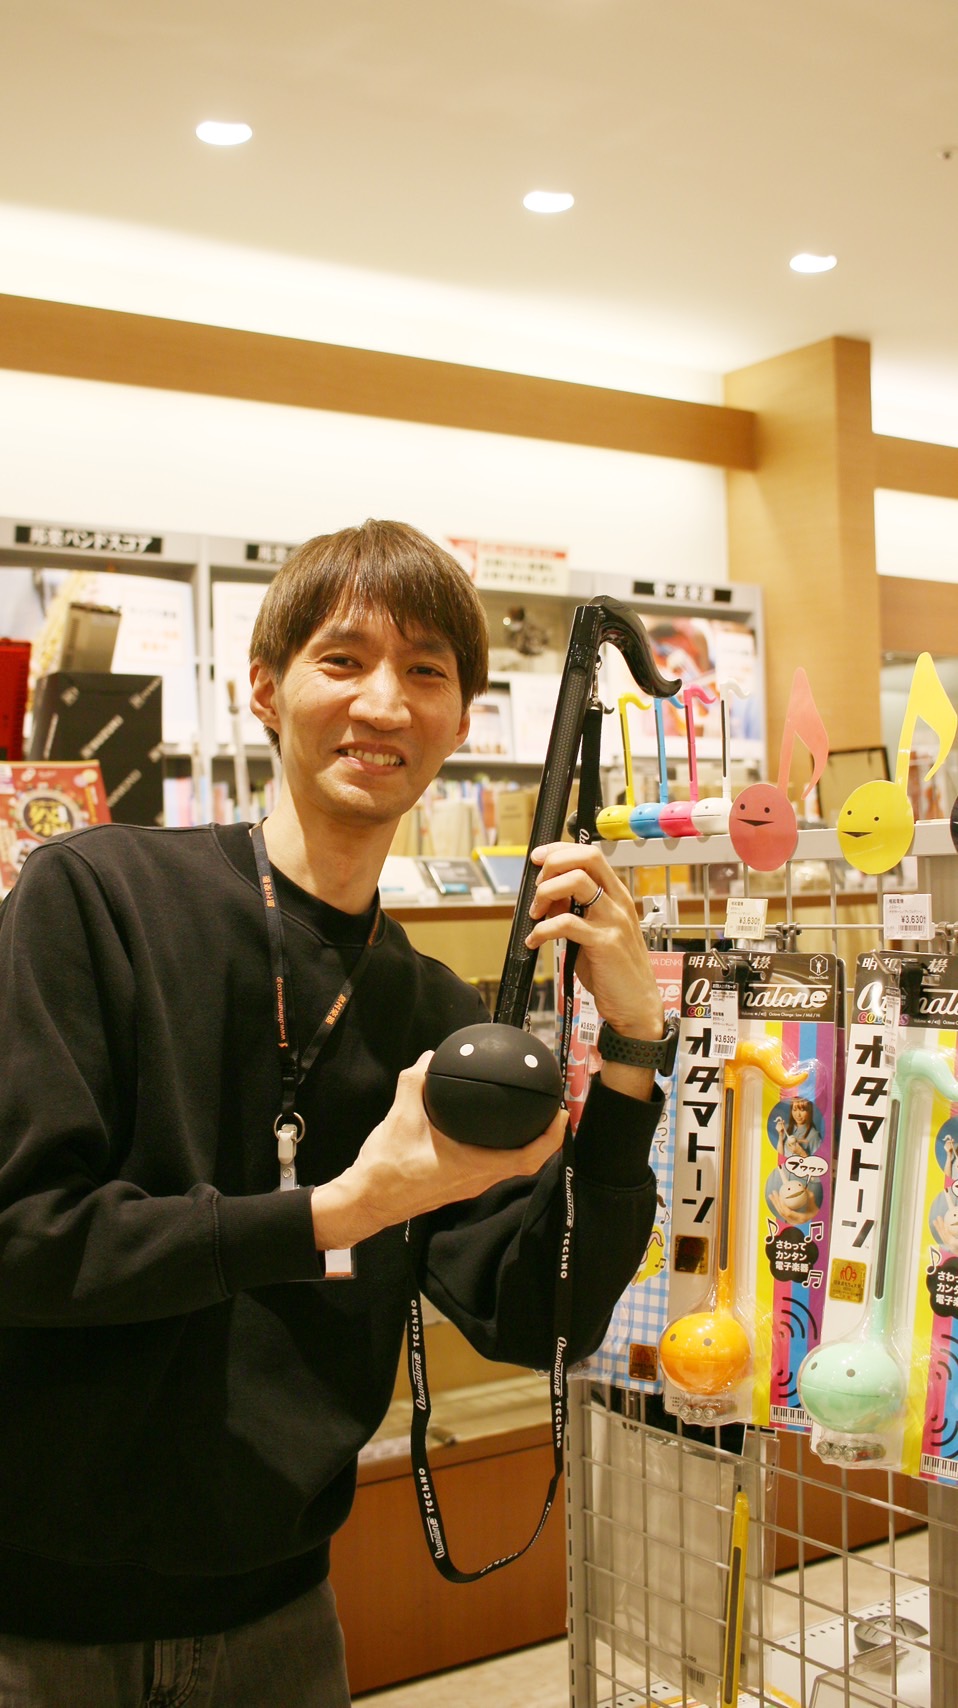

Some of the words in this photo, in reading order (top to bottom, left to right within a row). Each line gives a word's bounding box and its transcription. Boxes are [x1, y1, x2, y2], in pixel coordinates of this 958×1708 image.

[682, 1028, 720, 1223] オタマトーン
[841, 1035, 889, 1248] オタマトーン
[775, 1240, 807, 1251] さわって
[775, 1250, 807, 1261] カンタン
[775, 1261, 809, 1273] 電子楽器
